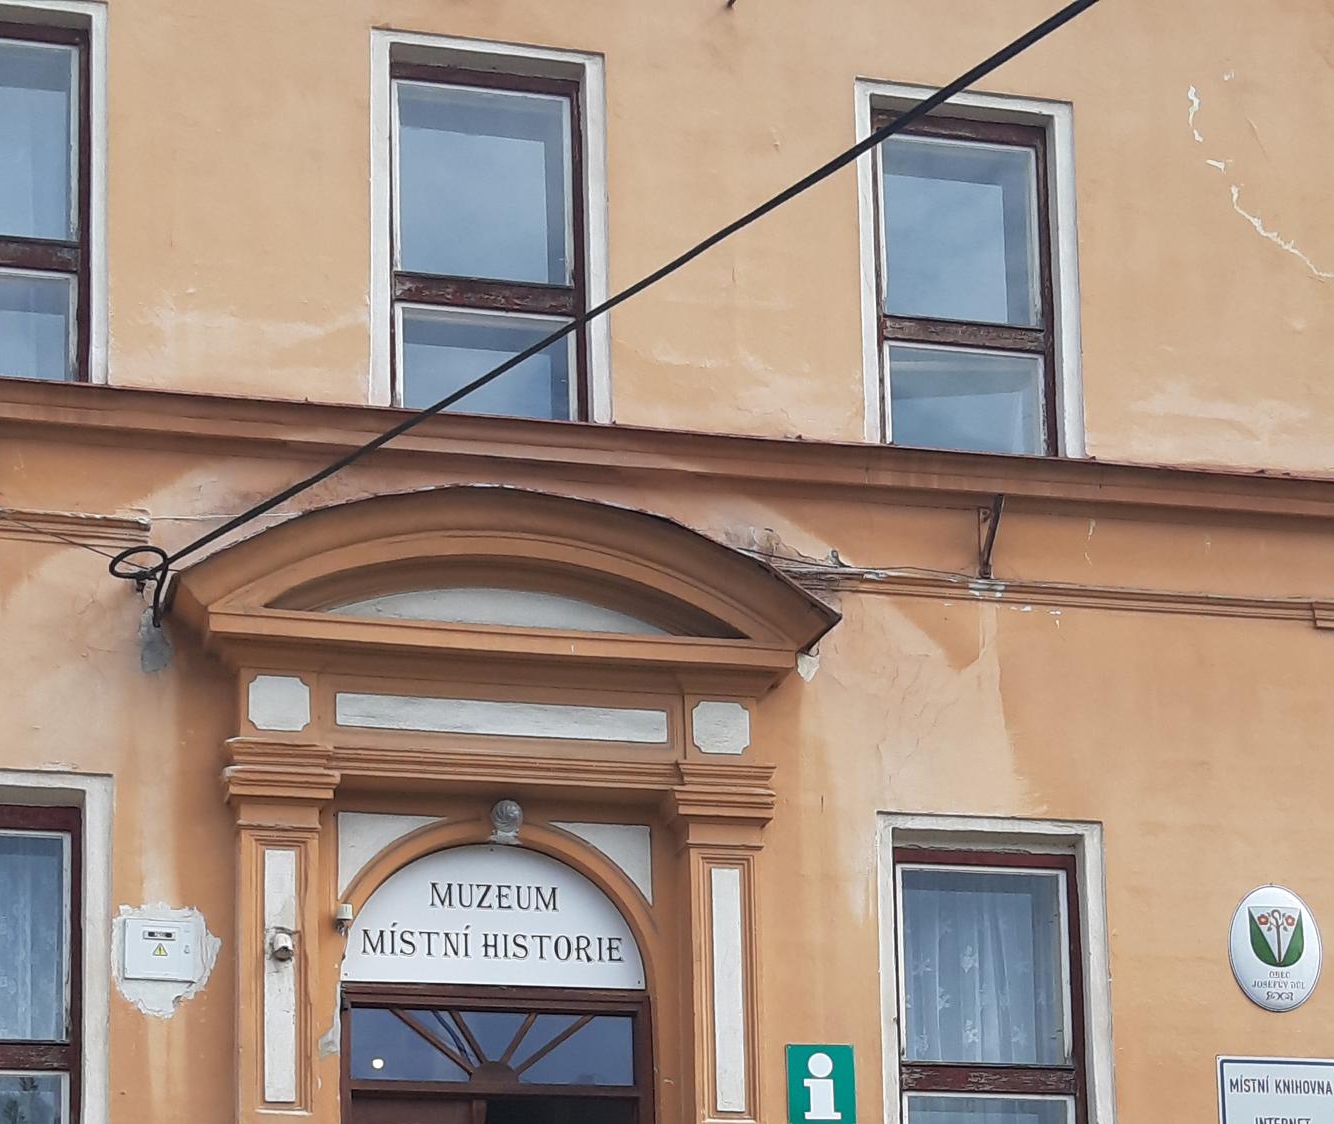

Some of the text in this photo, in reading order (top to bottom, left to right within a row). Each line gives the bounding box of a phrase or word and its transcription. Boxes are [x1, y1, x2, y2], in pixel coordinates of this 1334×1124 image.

[429, 881, 560, 912] MUZEUM
[361, 921, 625, 963] MÍSTNÍ HISTORIE
[1229, 1074, 1333, 1096] MÍSTNÍ KNIHOVNA
